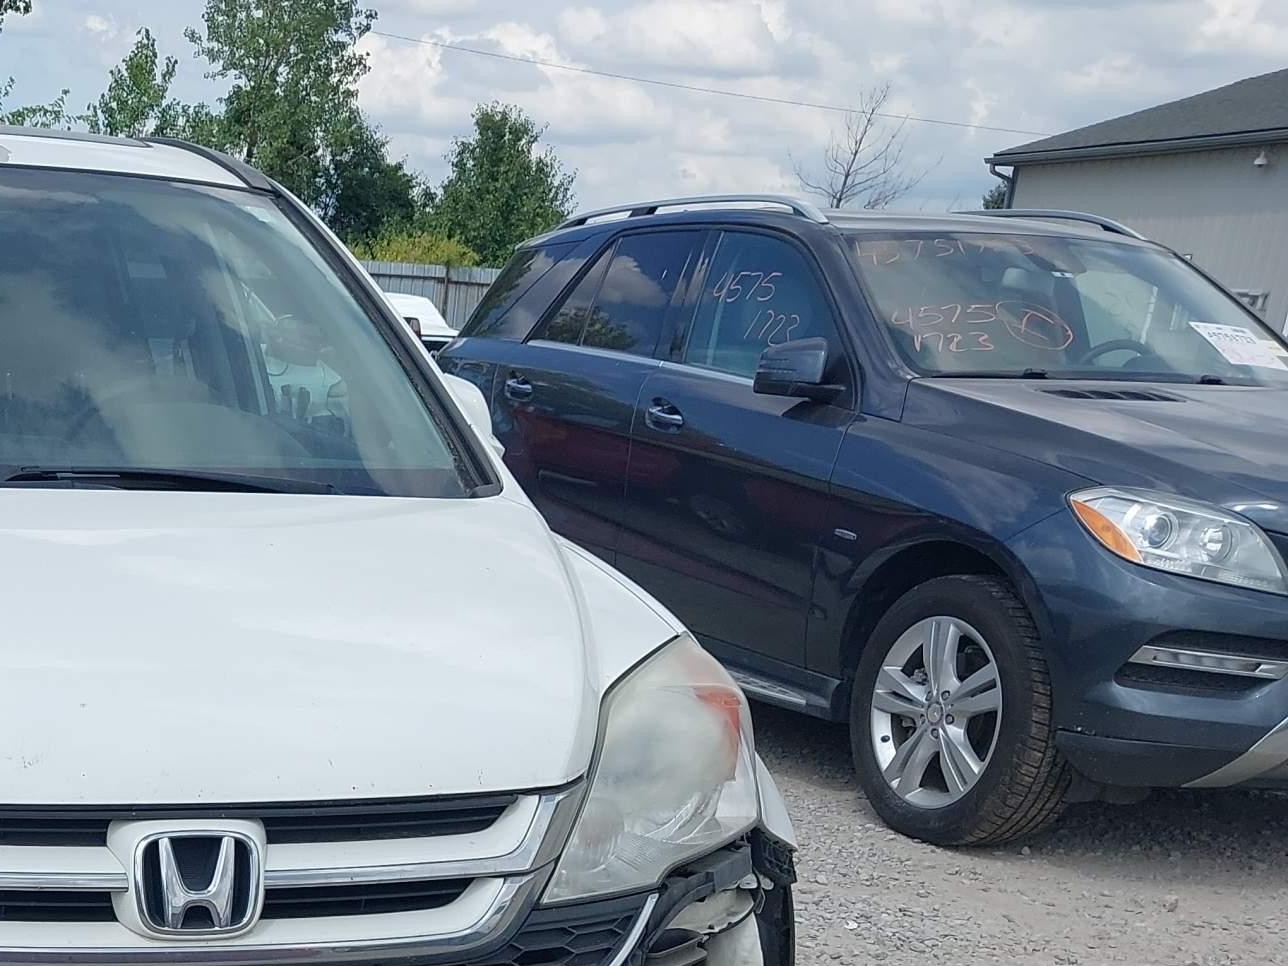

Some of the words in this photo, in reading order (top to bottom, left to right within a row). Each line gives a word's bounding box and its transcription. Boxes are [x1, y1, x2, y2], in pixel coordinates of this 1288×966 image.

[713, 271, 783, 303] 4575
[891, 303, 996, 329] 4575
[914, 331, 994, 352] 1723
